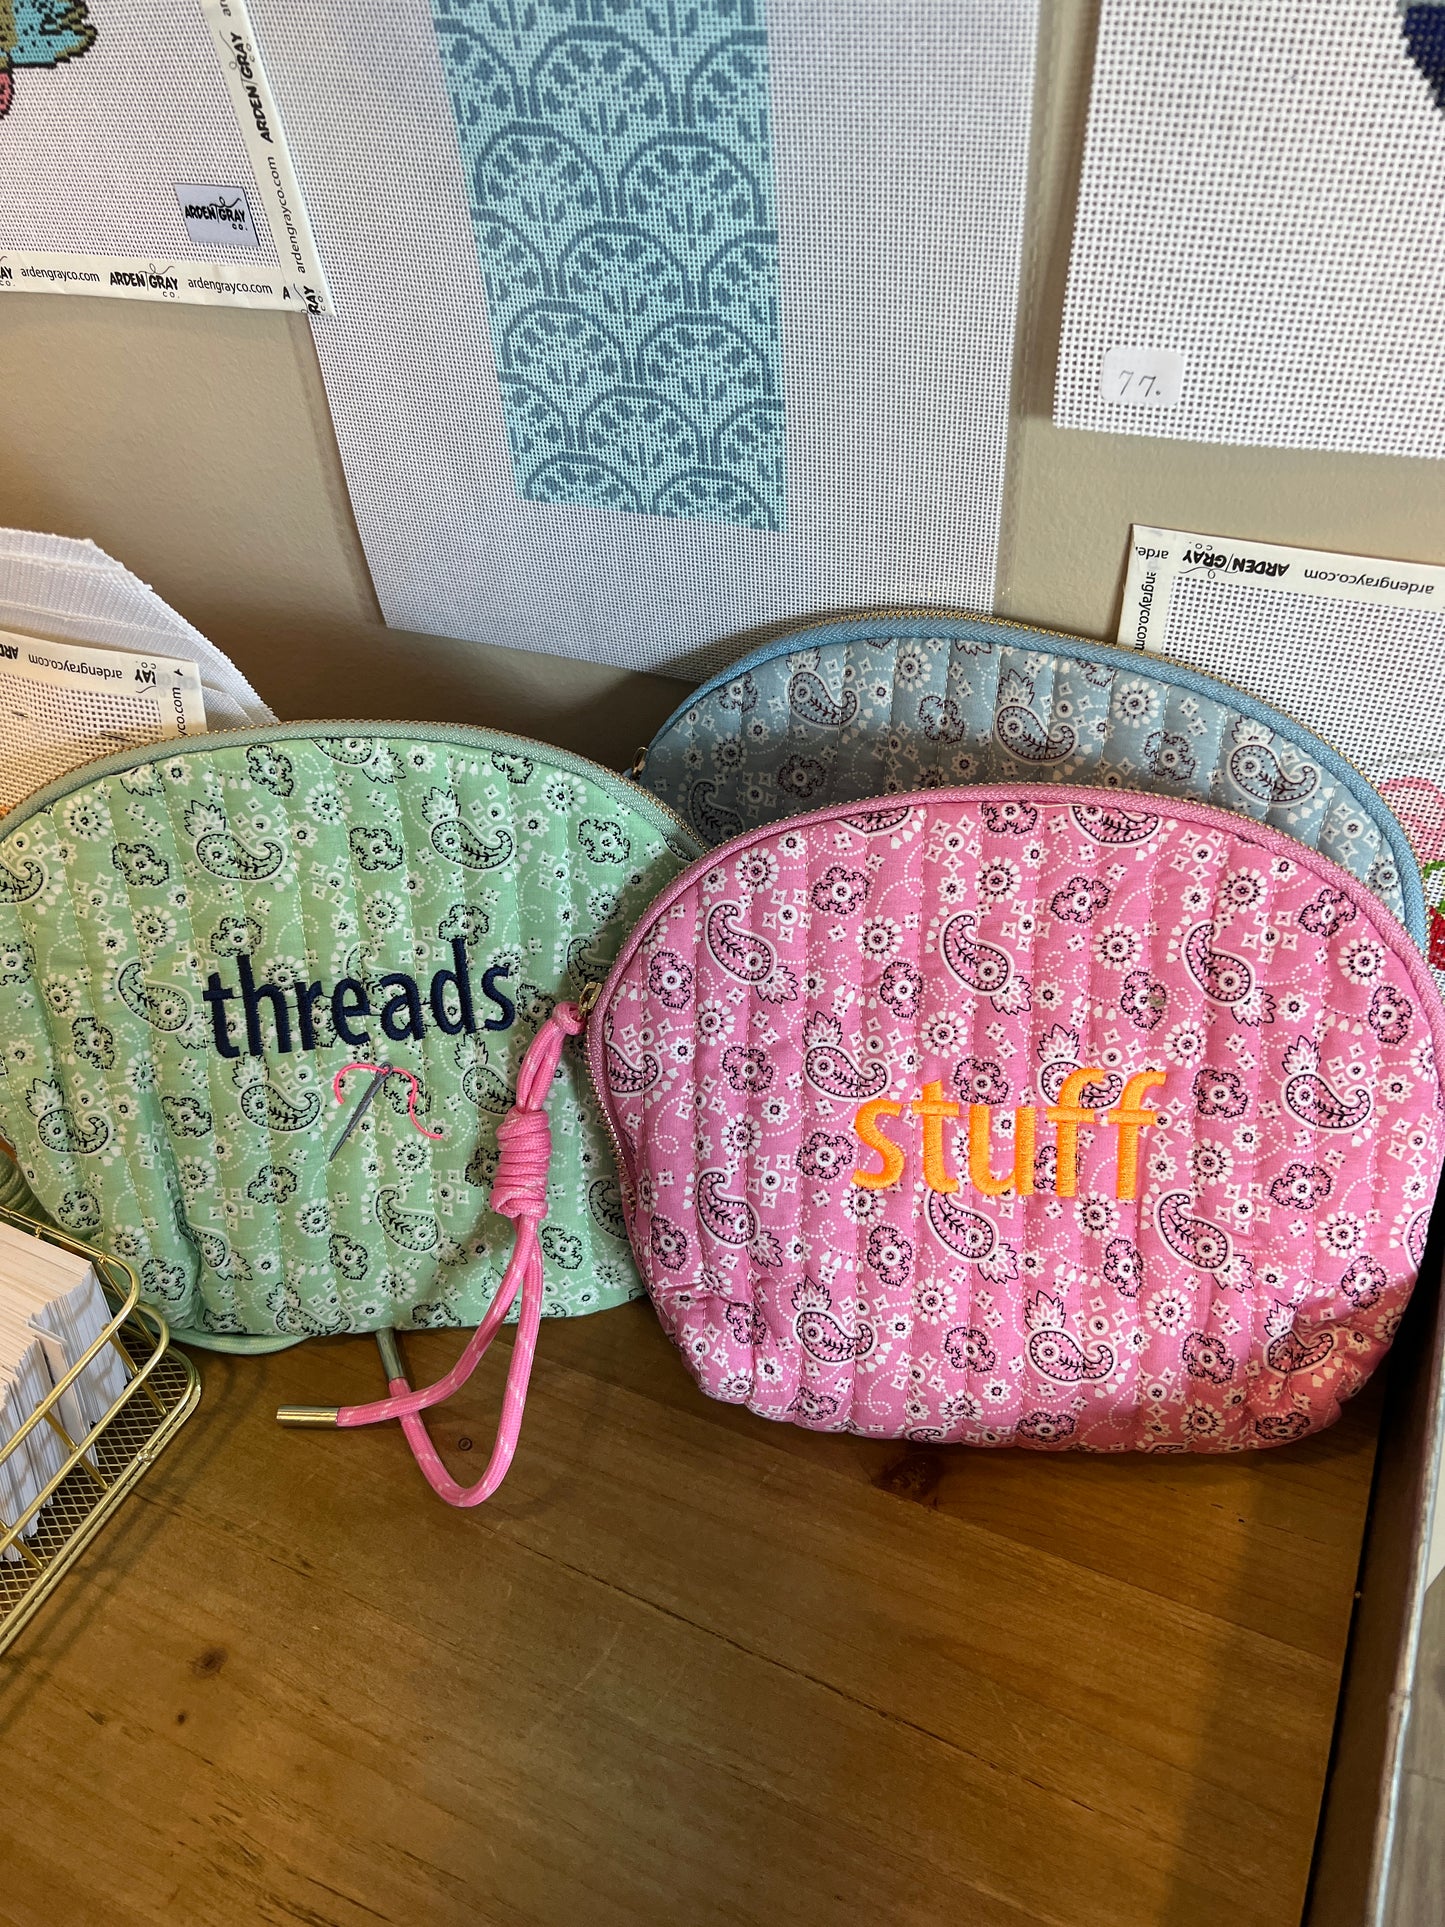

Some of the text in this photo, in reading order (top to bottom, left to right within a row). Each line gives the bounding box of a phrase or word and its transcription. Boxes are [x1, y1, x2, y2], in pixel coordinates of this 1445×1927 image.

[230, 31, 274, 143] ARDEN GRAY
[184, 204, 246, 223] ARDEN GRAY
[267, 156, 306, 274] ardengrayco.com
[0, 266, 13, 280] AY
[20, 265, 101, 284] ardengrayco.com
[109, 271, 146, 288] ARDEN
[148, 274, 179, 291] GRAY
[187, 278, 274, 296] ardengrayco.com
[1135, 546, 1435, 595] arde ARDEN GRAY ardengrayco.com
[28, 653, 123, 680] ardengrayco.com
[202, 938, 516, 1059] threads
[851, 1067, 1167, 1200] stuff
